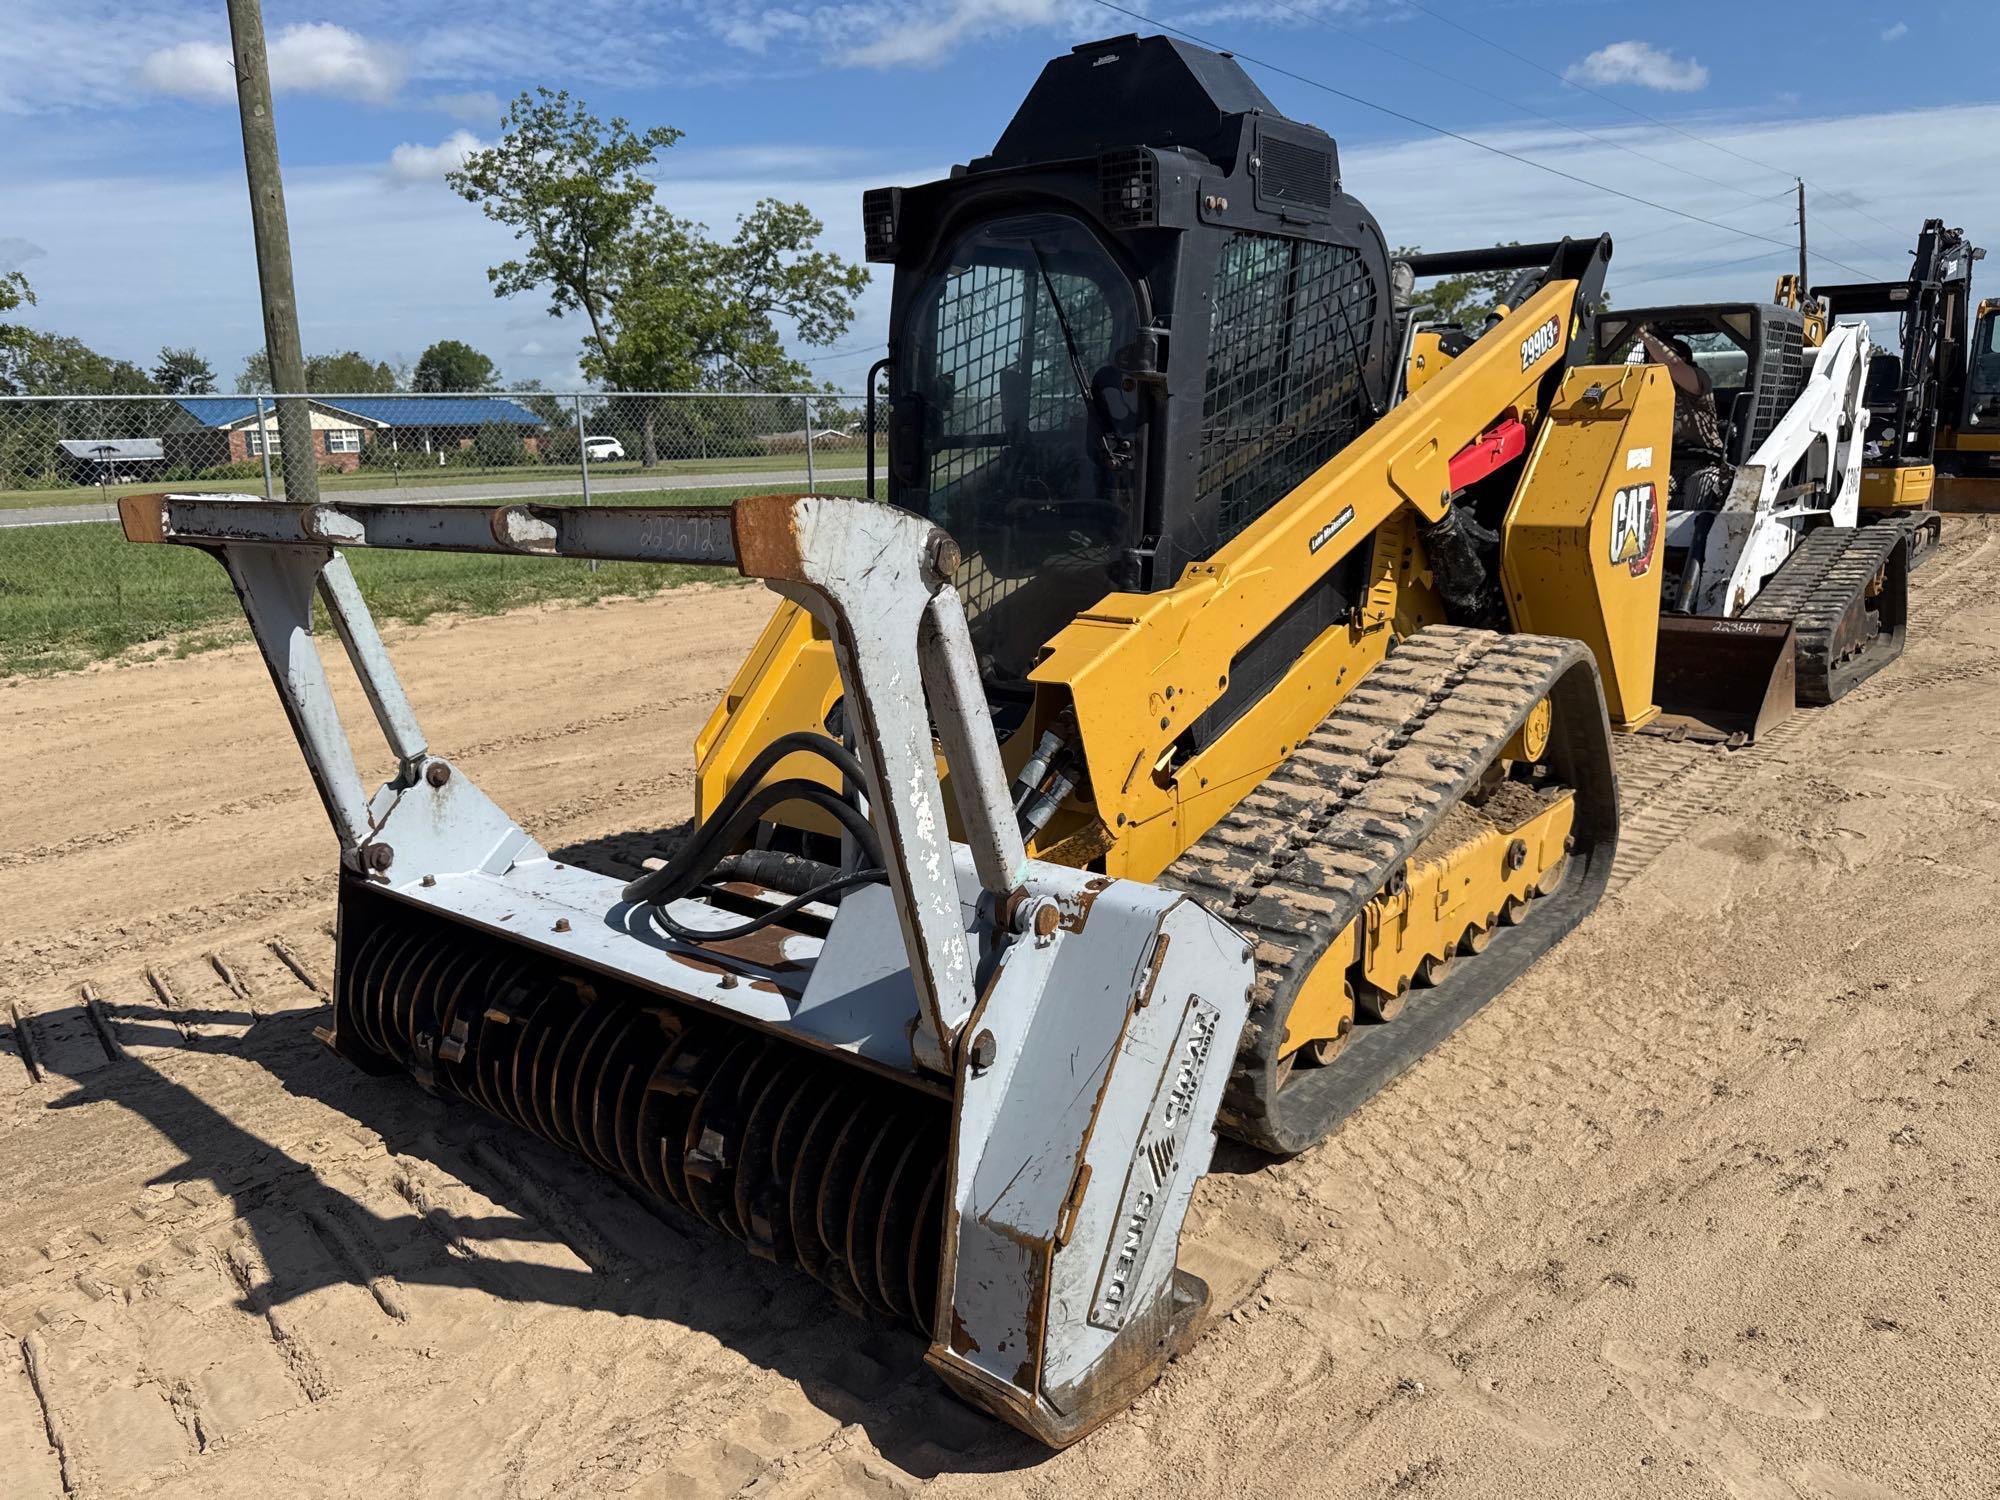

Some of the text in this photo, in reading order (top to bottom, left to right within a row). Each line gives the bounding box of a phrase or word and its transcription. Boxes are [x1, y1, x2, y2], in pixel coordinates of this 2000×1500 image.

[640, 517, 715, 552] 223672
[1611, 486, 1651, 563] CAT
[1711, 621, 1762, 634] 223664
[1103, 1011, 1207, 1312] DENIS CIMAF
